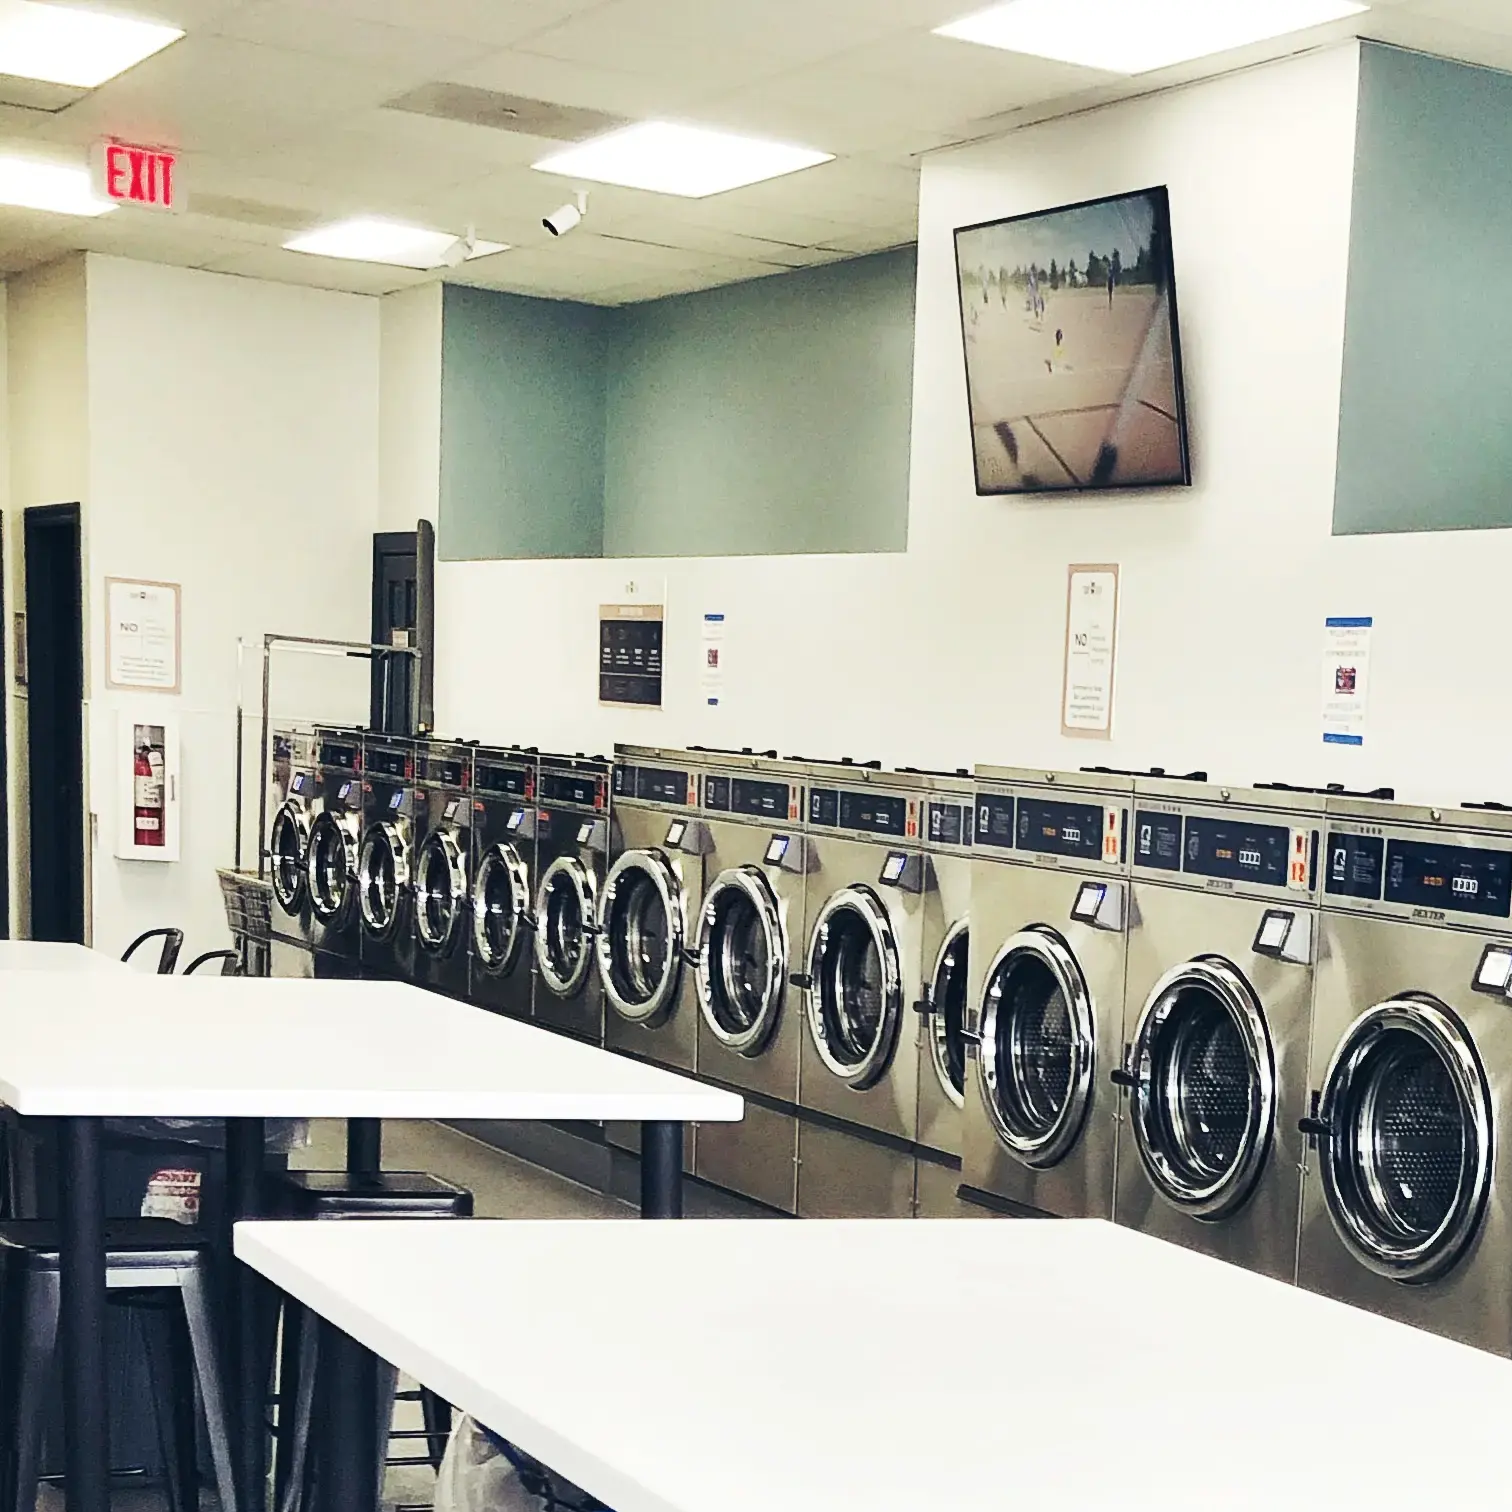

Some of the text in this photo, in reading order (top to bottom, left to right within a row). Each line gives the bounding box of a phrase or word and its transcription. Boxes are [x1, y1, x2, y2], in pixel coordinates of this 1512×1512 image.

[106, 147, 175, 205] EXIT
[120, 622, 138, 633] NO
[1075, 633, 1087, 647] NO
[1411, 908, 1446, 921] DEXTER
